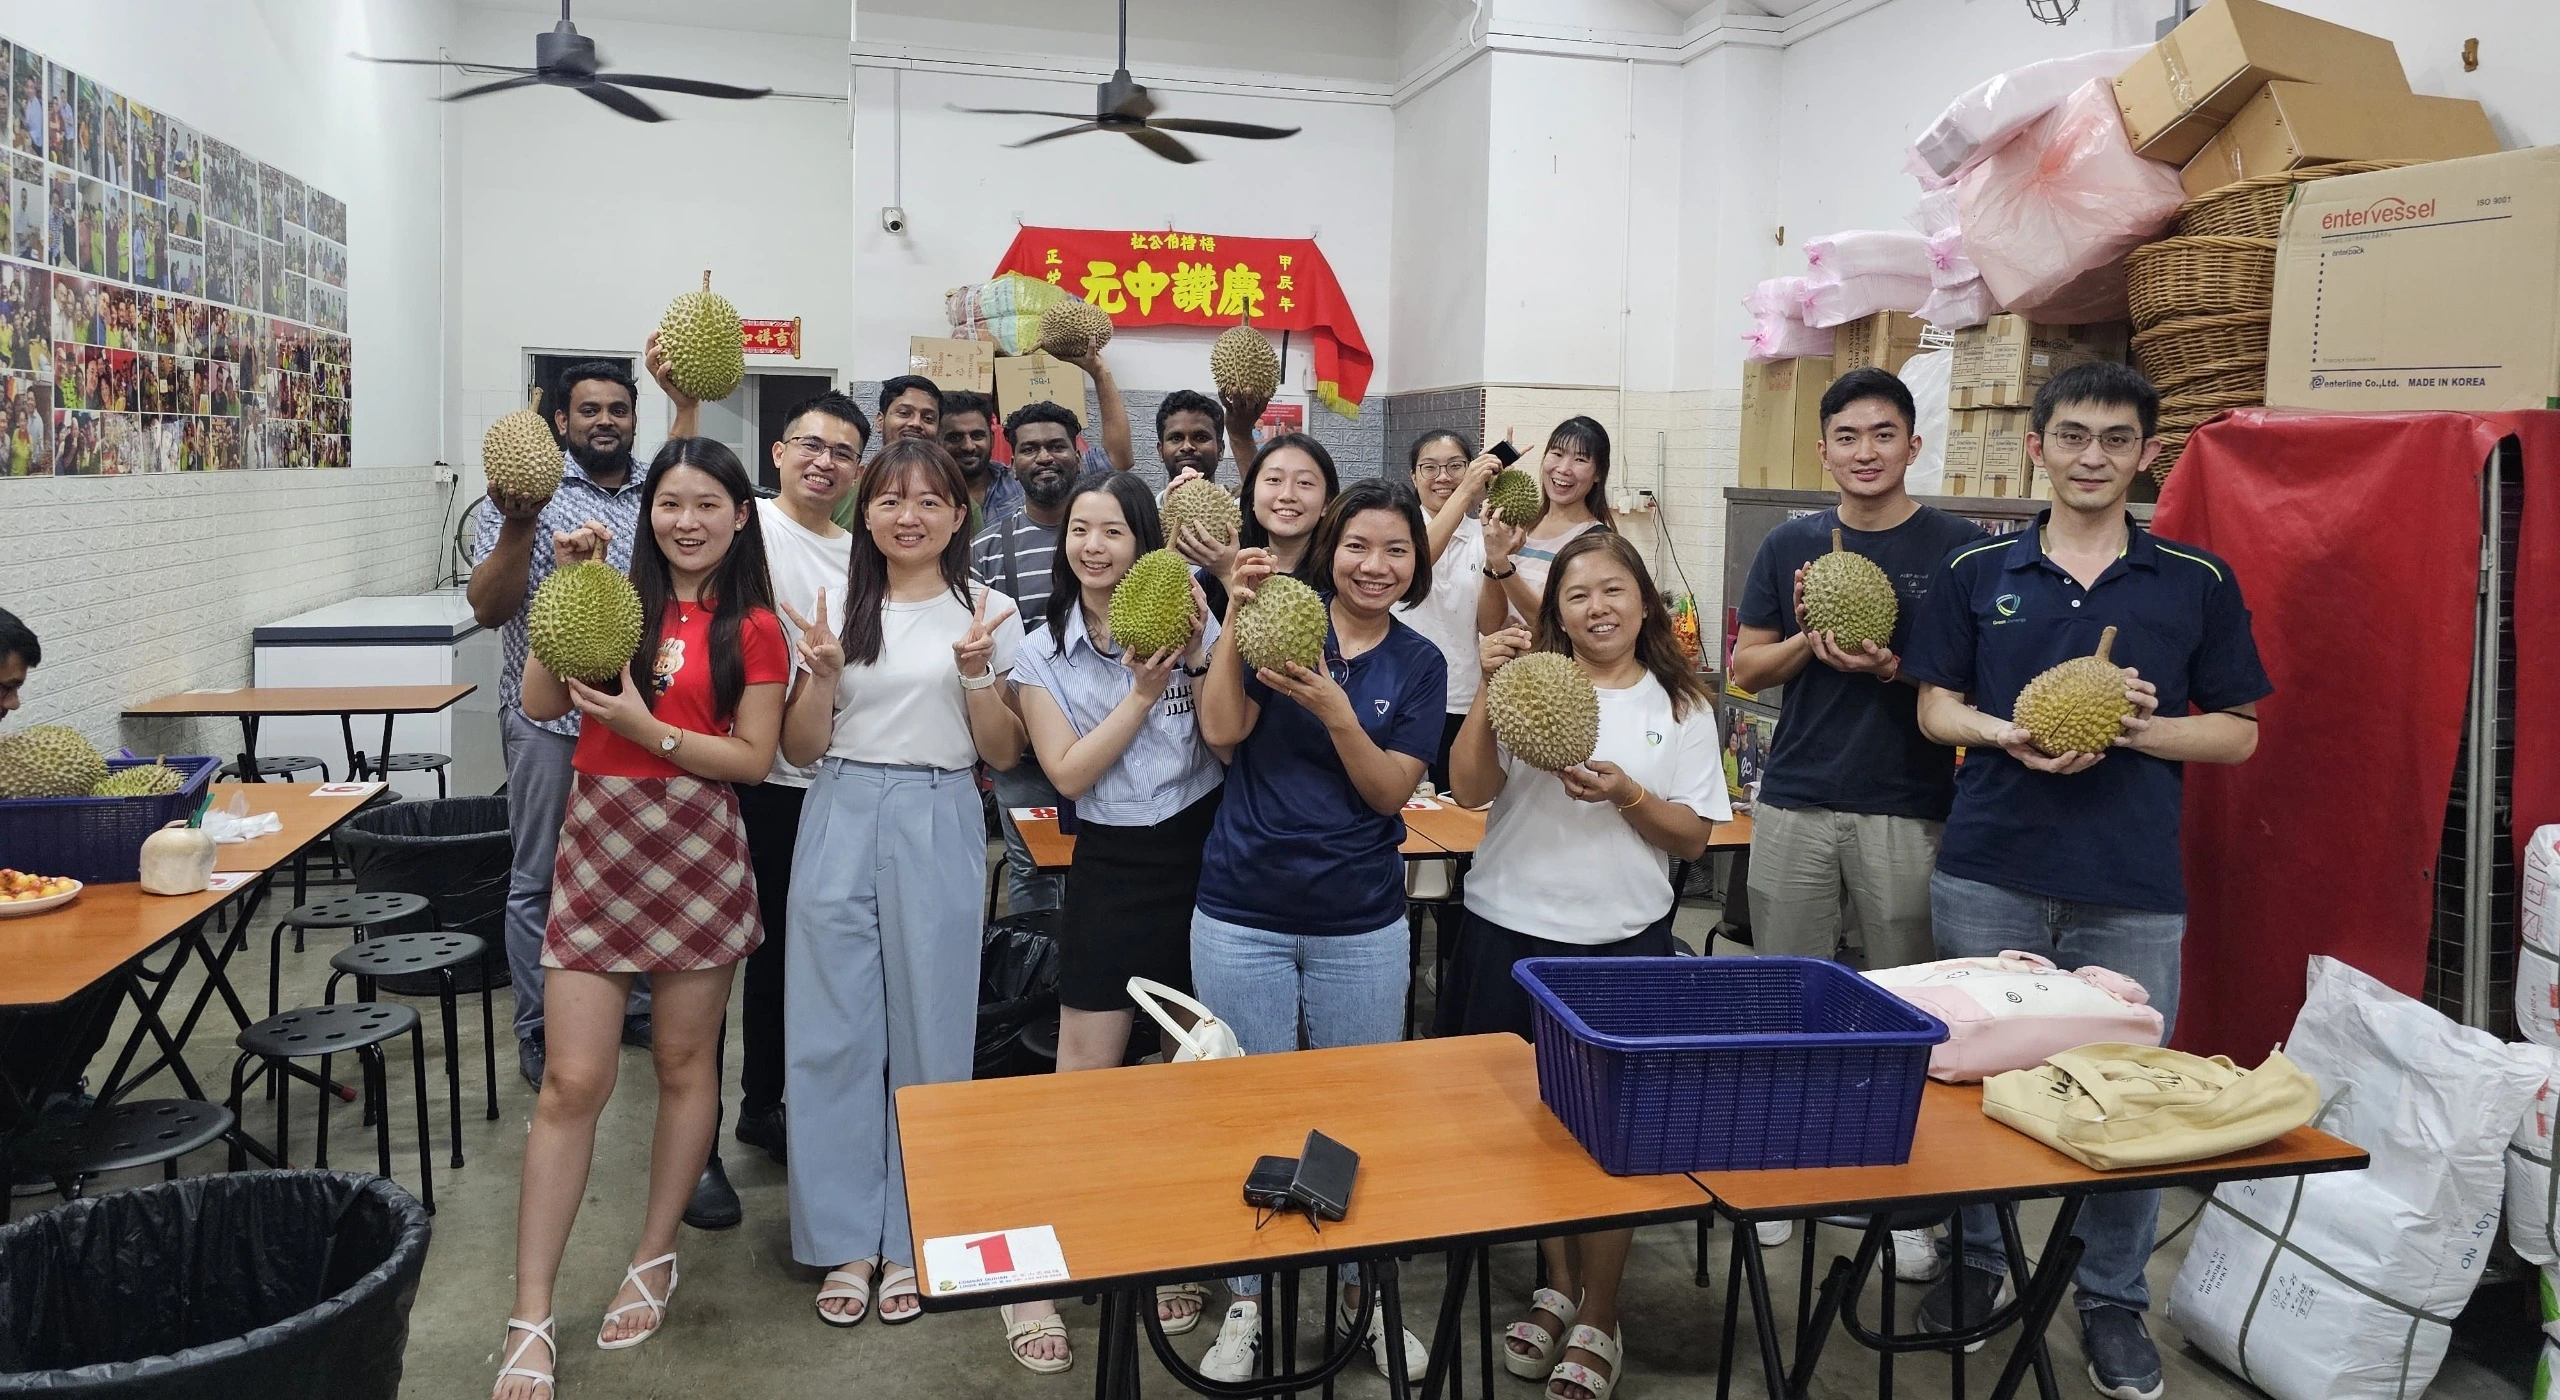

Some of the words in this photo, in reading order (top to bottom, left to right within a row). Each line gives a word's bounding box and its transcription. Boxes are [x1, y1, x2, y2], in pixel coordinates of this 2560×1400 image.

[2476, 198, 2491, 207] ISO
[2365, 377, 2400, 389] Co.,Ltd.
[2408, 377, 2436, 387] MADE
[2438, 377, 2448, 386] IN
[2451, 377, 2486, 387] KOREA
[2472, 1212, 2498, 1238] LOT
[965, 1233, 1015, 1274] 1
[2461, 1247, 2478, 1270] NO
